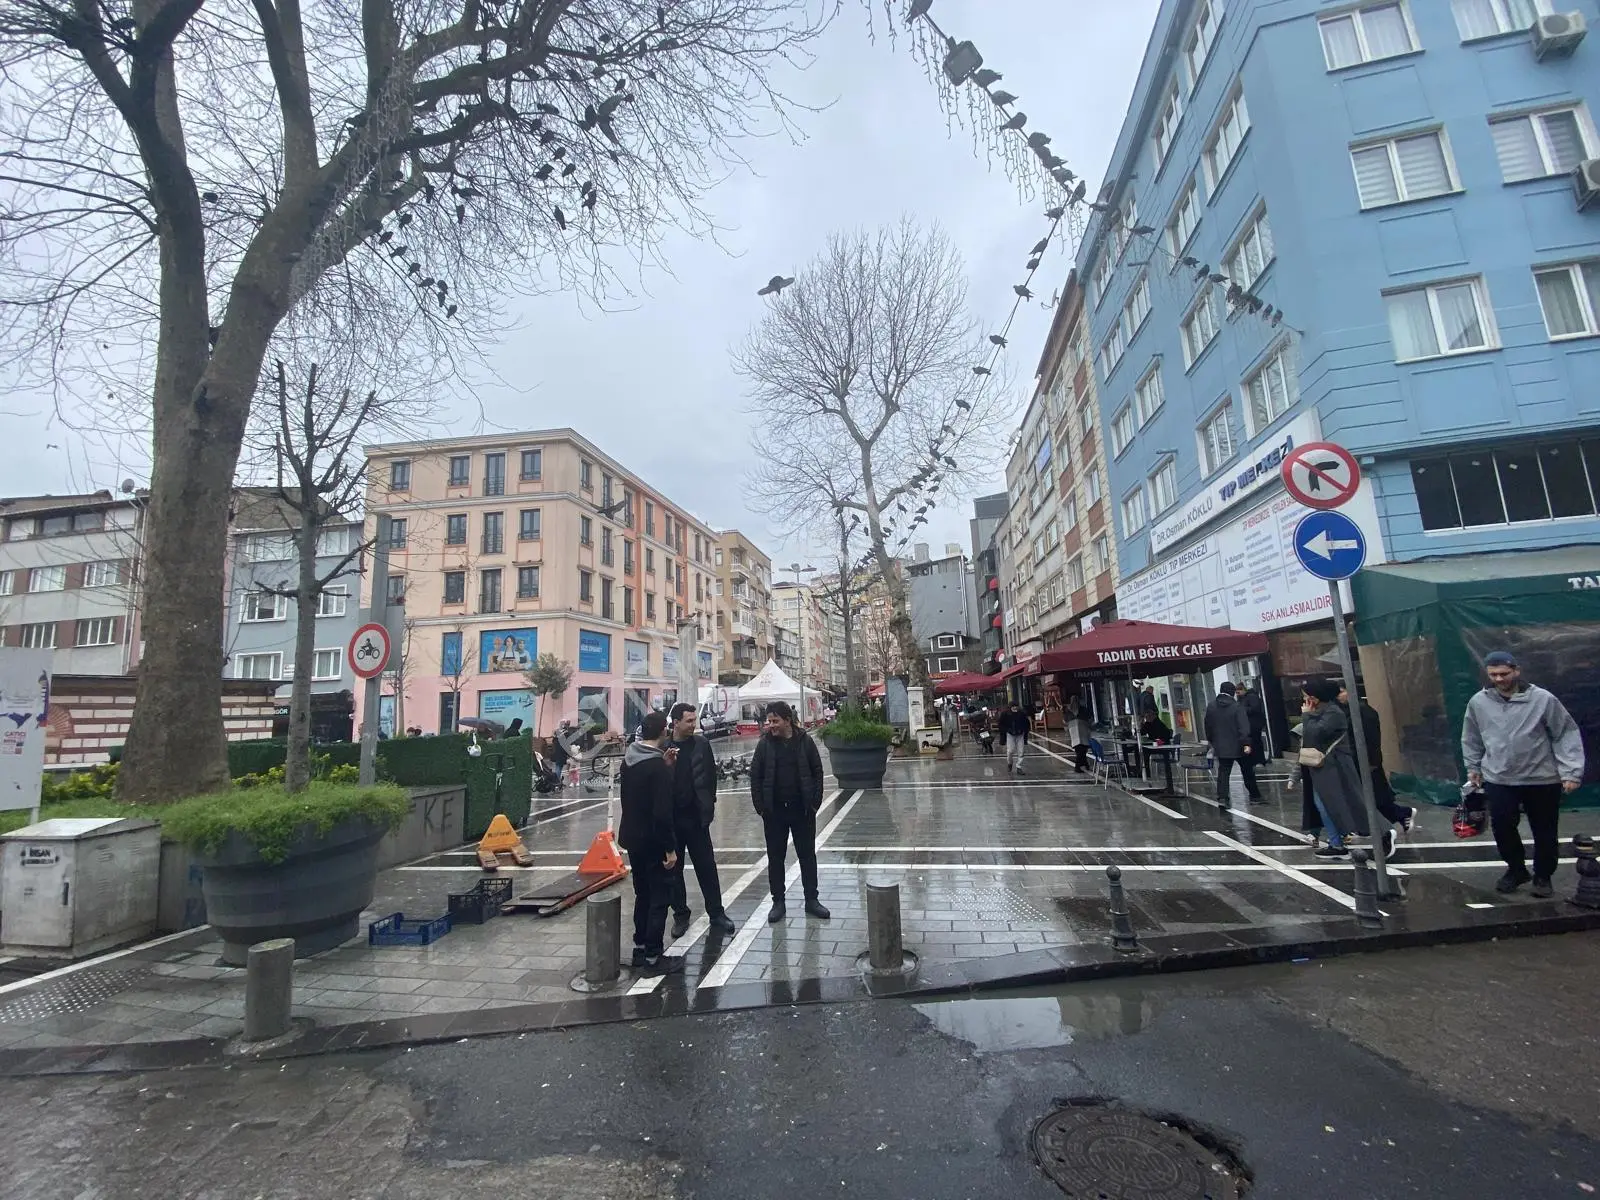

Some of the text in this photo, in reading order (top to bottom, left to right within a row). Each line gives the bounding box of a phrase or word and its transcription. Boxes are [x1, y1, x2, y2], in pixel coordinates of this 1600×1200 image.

[1178, 540, 1208, 567] MERKEZİ
[1567, 575, 1600, 589] TA
[1261, 609, 1275, 622] SGK
[1097, 643, 1213, 663] TADIM BÖREK CAFE
